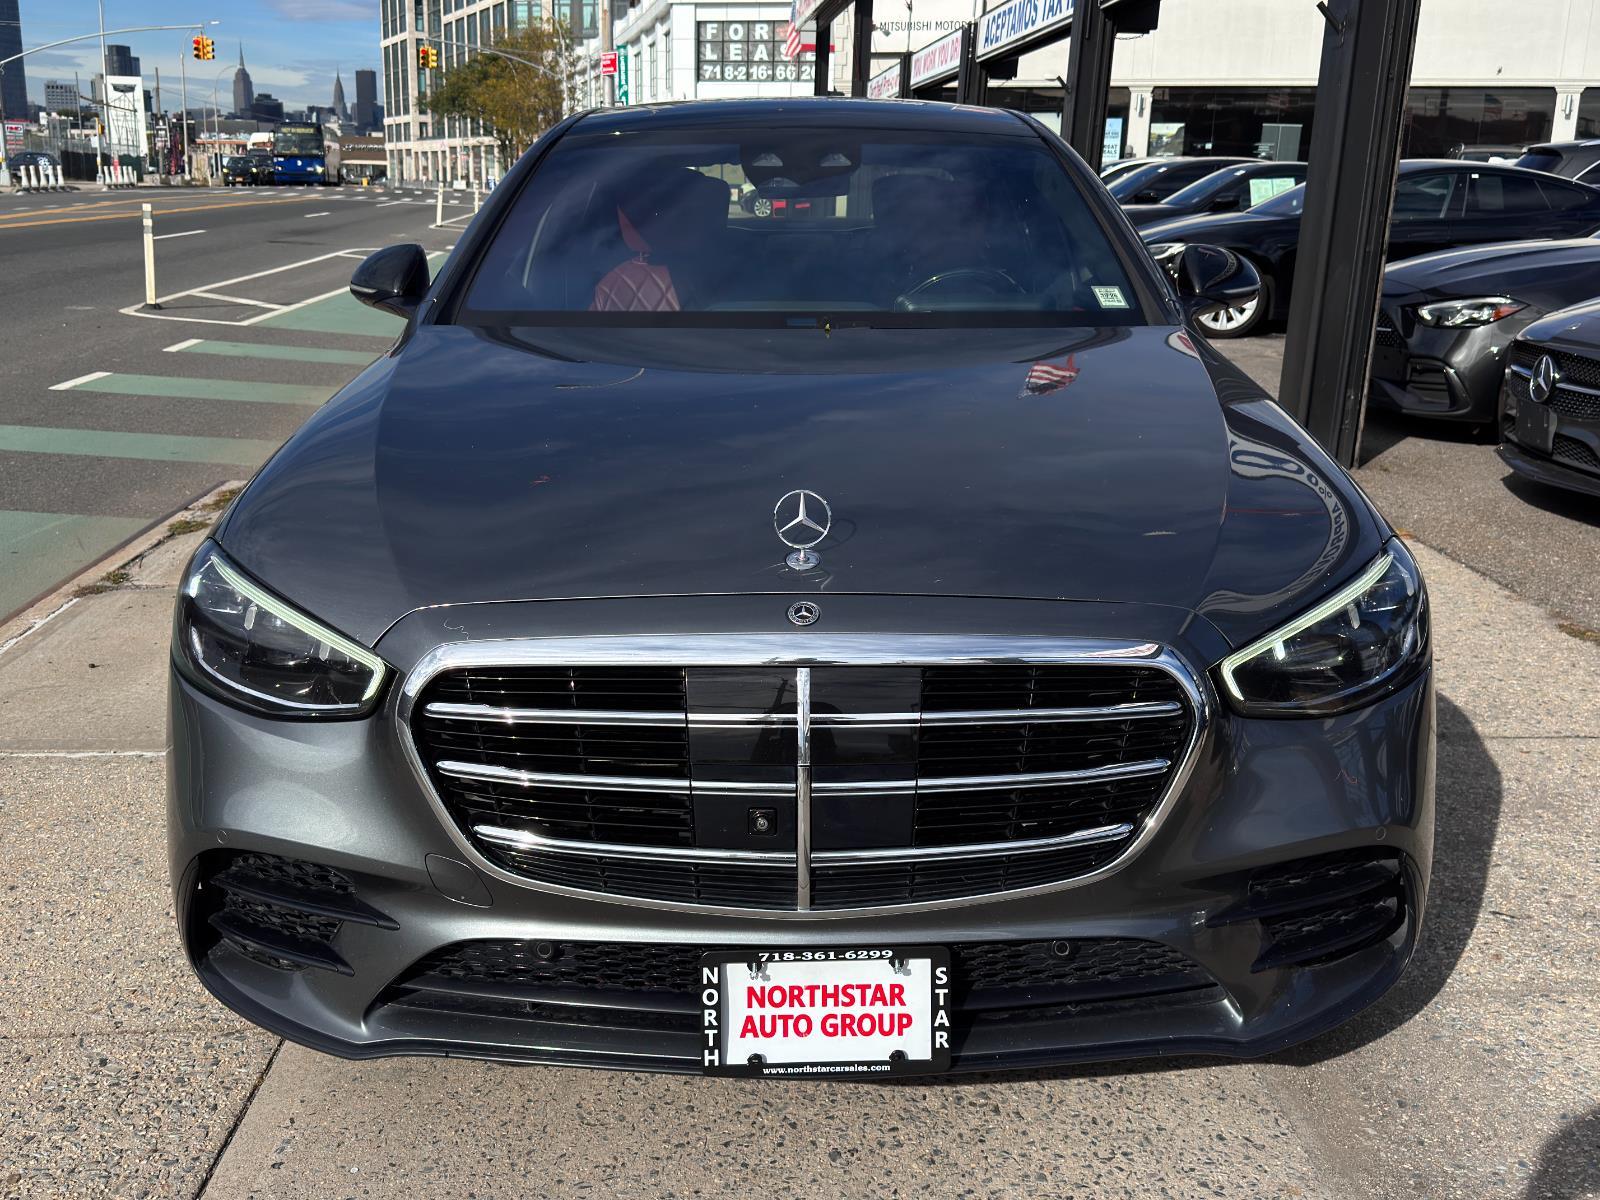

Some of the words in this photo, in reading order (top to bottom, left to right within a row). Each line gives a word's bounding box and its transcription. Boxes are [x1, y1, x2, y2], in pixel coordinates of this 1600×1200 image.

[706, 23, 769, 40] FOR
[880, 21, 932, 31] MITSUBISHI
[983, 0, 1038, 48] ACEPTAMOS
[758, 949, 893, 962] 718-361-6299
[746, 983, 906, 1009] NORTHSTAR
[933, 966, 949, 1049] STAR
[702, 966, 719, 1067] NORTH
[739, 1013, 813, 1039] AUTO
[820, 1012, 913, 1037] GROUP
[762, 1063, 891, 1075] www.northstarcarsales.com
